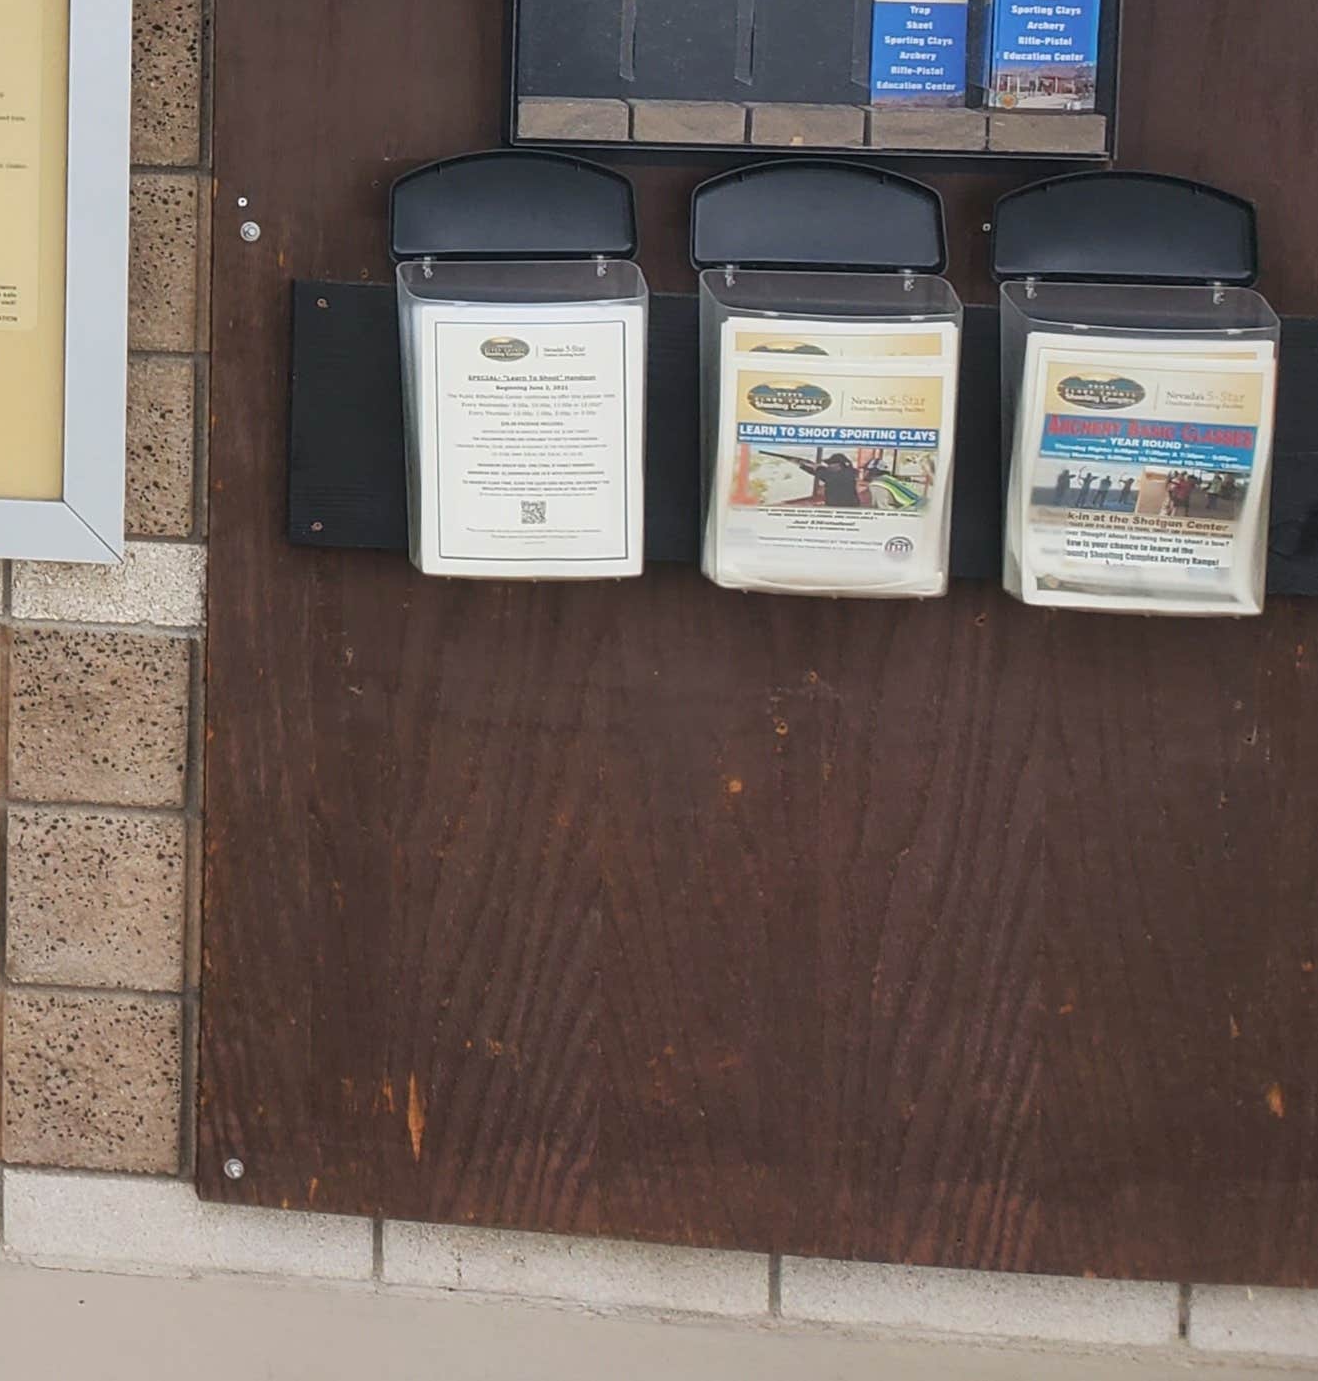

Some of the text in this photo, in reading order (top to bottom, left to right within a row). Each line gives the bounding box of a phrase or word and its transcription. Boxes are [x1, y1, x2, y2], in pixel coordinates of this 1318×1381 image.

[910, 6, 931, 16] Trap
[1011, 5, 1081, 16] Sporting Clays
[906, 20, 933, 30] Skeet
[1027, 21, 1065, 31] Archery
[884, 36, 953, 46] Sporting Clays
[1018, 36, 1072, 46] Rifle-Pistol
[899, 51, 937, 62] Archery
[1003, 51, 1084, 62] Education Center
[890, 66, 944, 76] Rifle-Pistol
[876, 81, 955, 91] Education Center
[740, 425, 936, 441] LEARN TO SHOOT SPORTING CLAYS
[1110, 437, 1182, 449] YEAR ROUND
